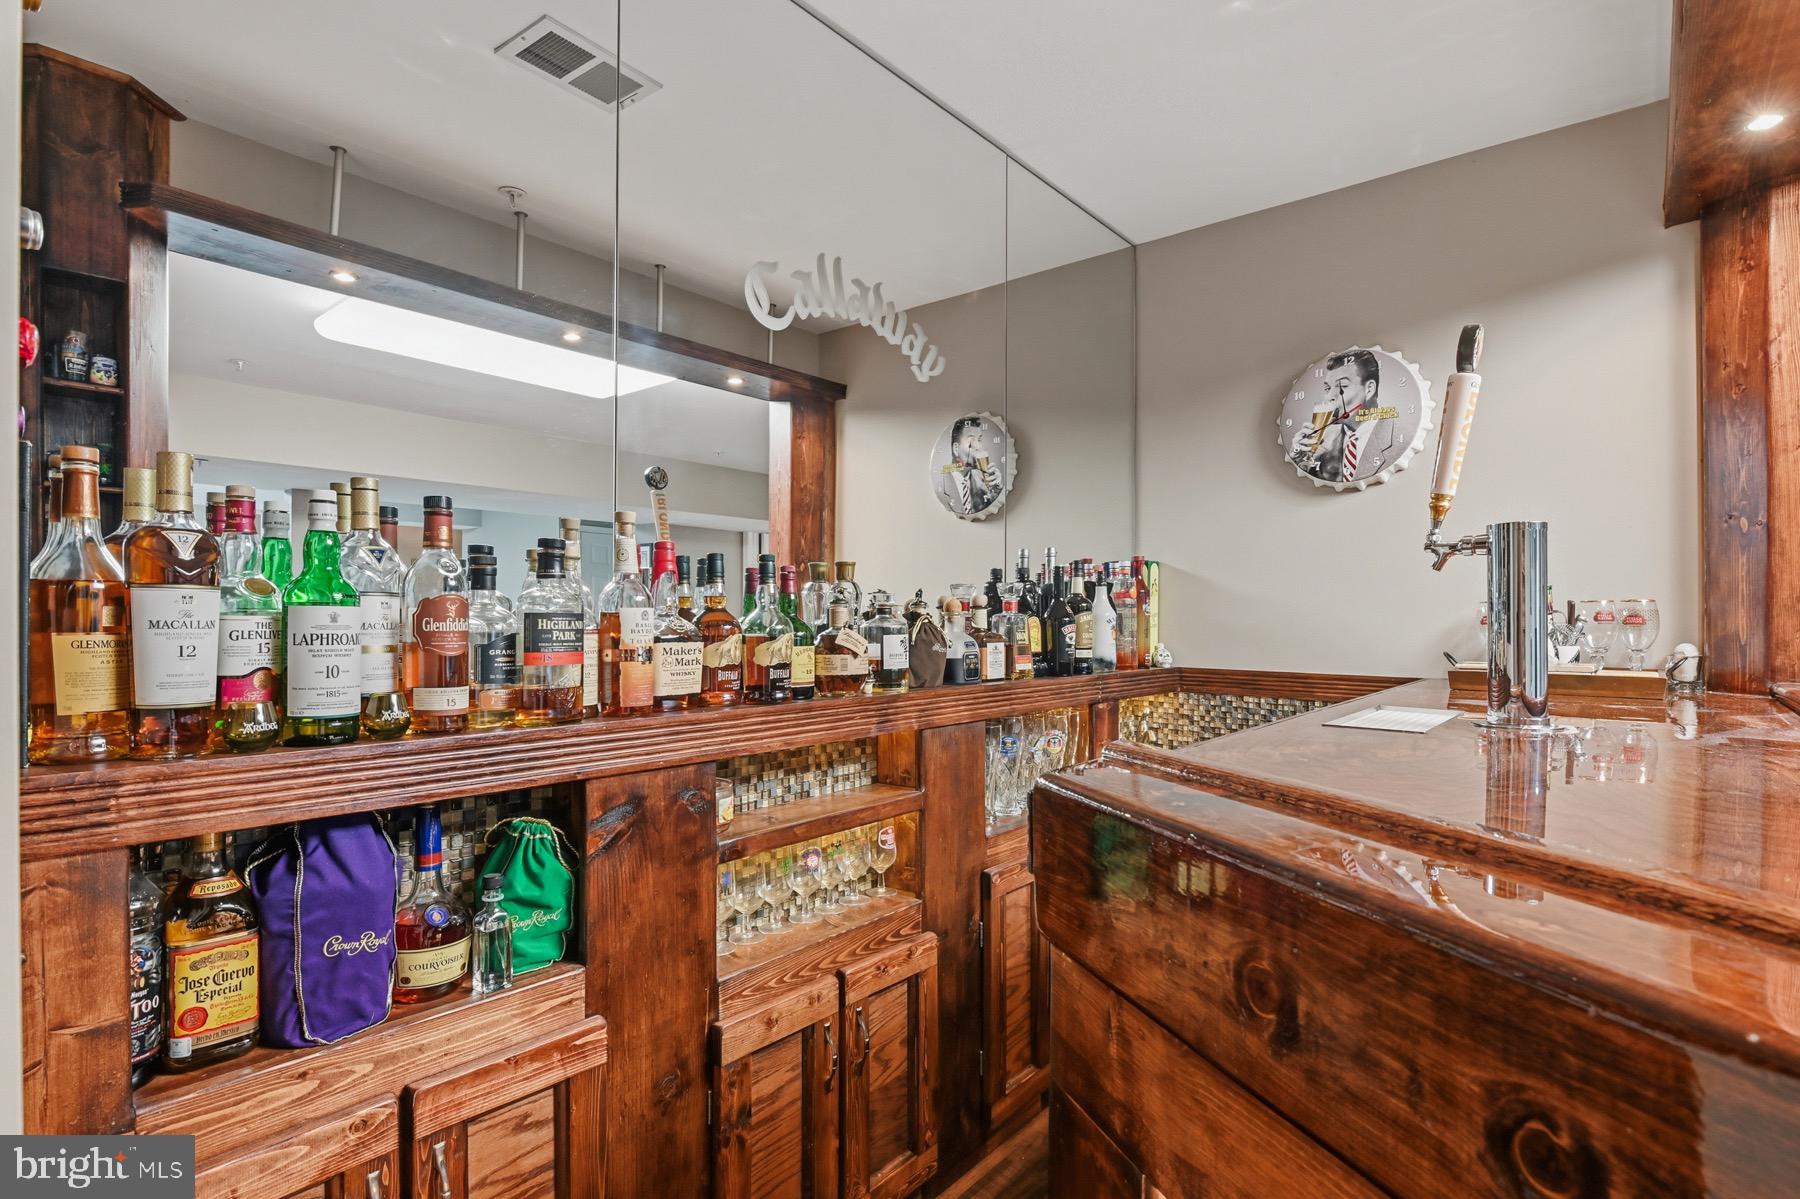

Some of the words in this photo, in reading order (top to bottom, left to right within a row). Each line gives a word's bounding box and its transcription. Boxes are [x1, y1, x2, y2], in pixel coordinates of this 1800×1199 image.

[745, 253, 946, 382] Callaway
[1344, 356, 1355, 365] 12
[1314, 369, 1324, 378] 11
[1294, 391, 1305, 400] 10
[1408, 405, 1415, 415] 3
[1286, 419, 1293, 428] 9
[1373, 458, 1380, 467] 5
[178, 535, 189, 544] 12
[147, 619, 216, 630] MACALLAN
[256, 621, 273, 630] THE
[552, 630, 576, 640] PARK
[177, 645, 197, 658] 12
[257, 642, 271, 654] 15
[662, 647, 702, 656] Maker's
[674, 657, 702, 667] Mark
[325, 664, 340, 679] 10
[325, 690, 341, 698] 1815
[446, 698, 457, 707] 15
[199, 880, 238, 893] Reposado
[528, 908, 563, 927] Royal
[322, 935, 360, 957] Crown
[351, 929, 392, 955] Royal
[408, 952, 465, 972] COURVOISIER
[178, 974, 210, 994] Jose
[212, 965, 256, 986] Cuervo
[195, 980, 243, 1003] Especial
